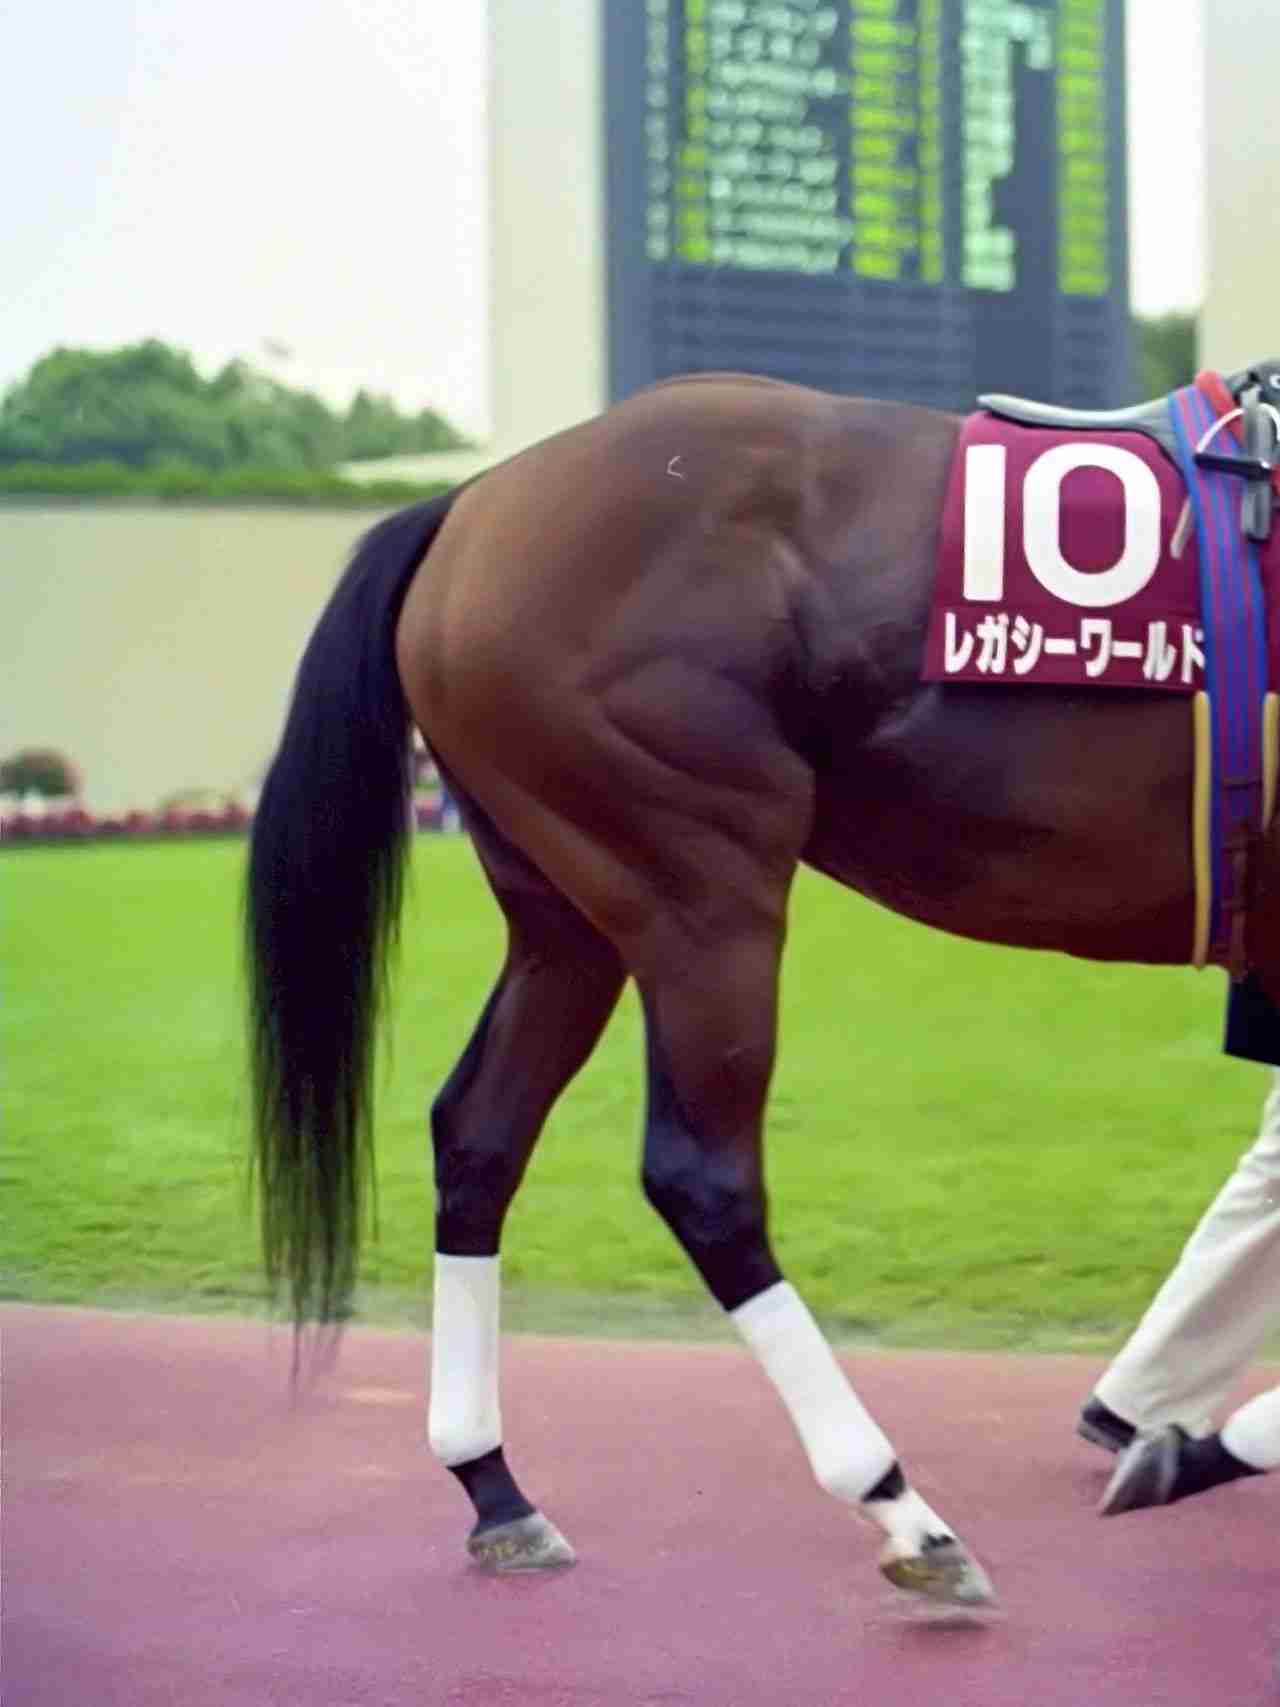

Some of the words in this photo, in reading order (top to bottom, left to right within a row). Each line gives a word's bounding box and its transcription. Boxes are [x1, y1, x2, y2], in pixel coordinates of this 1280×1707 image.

[963, 442, 1162, 608] 10
[944, 611, 1205, 684] レガシーワールド
